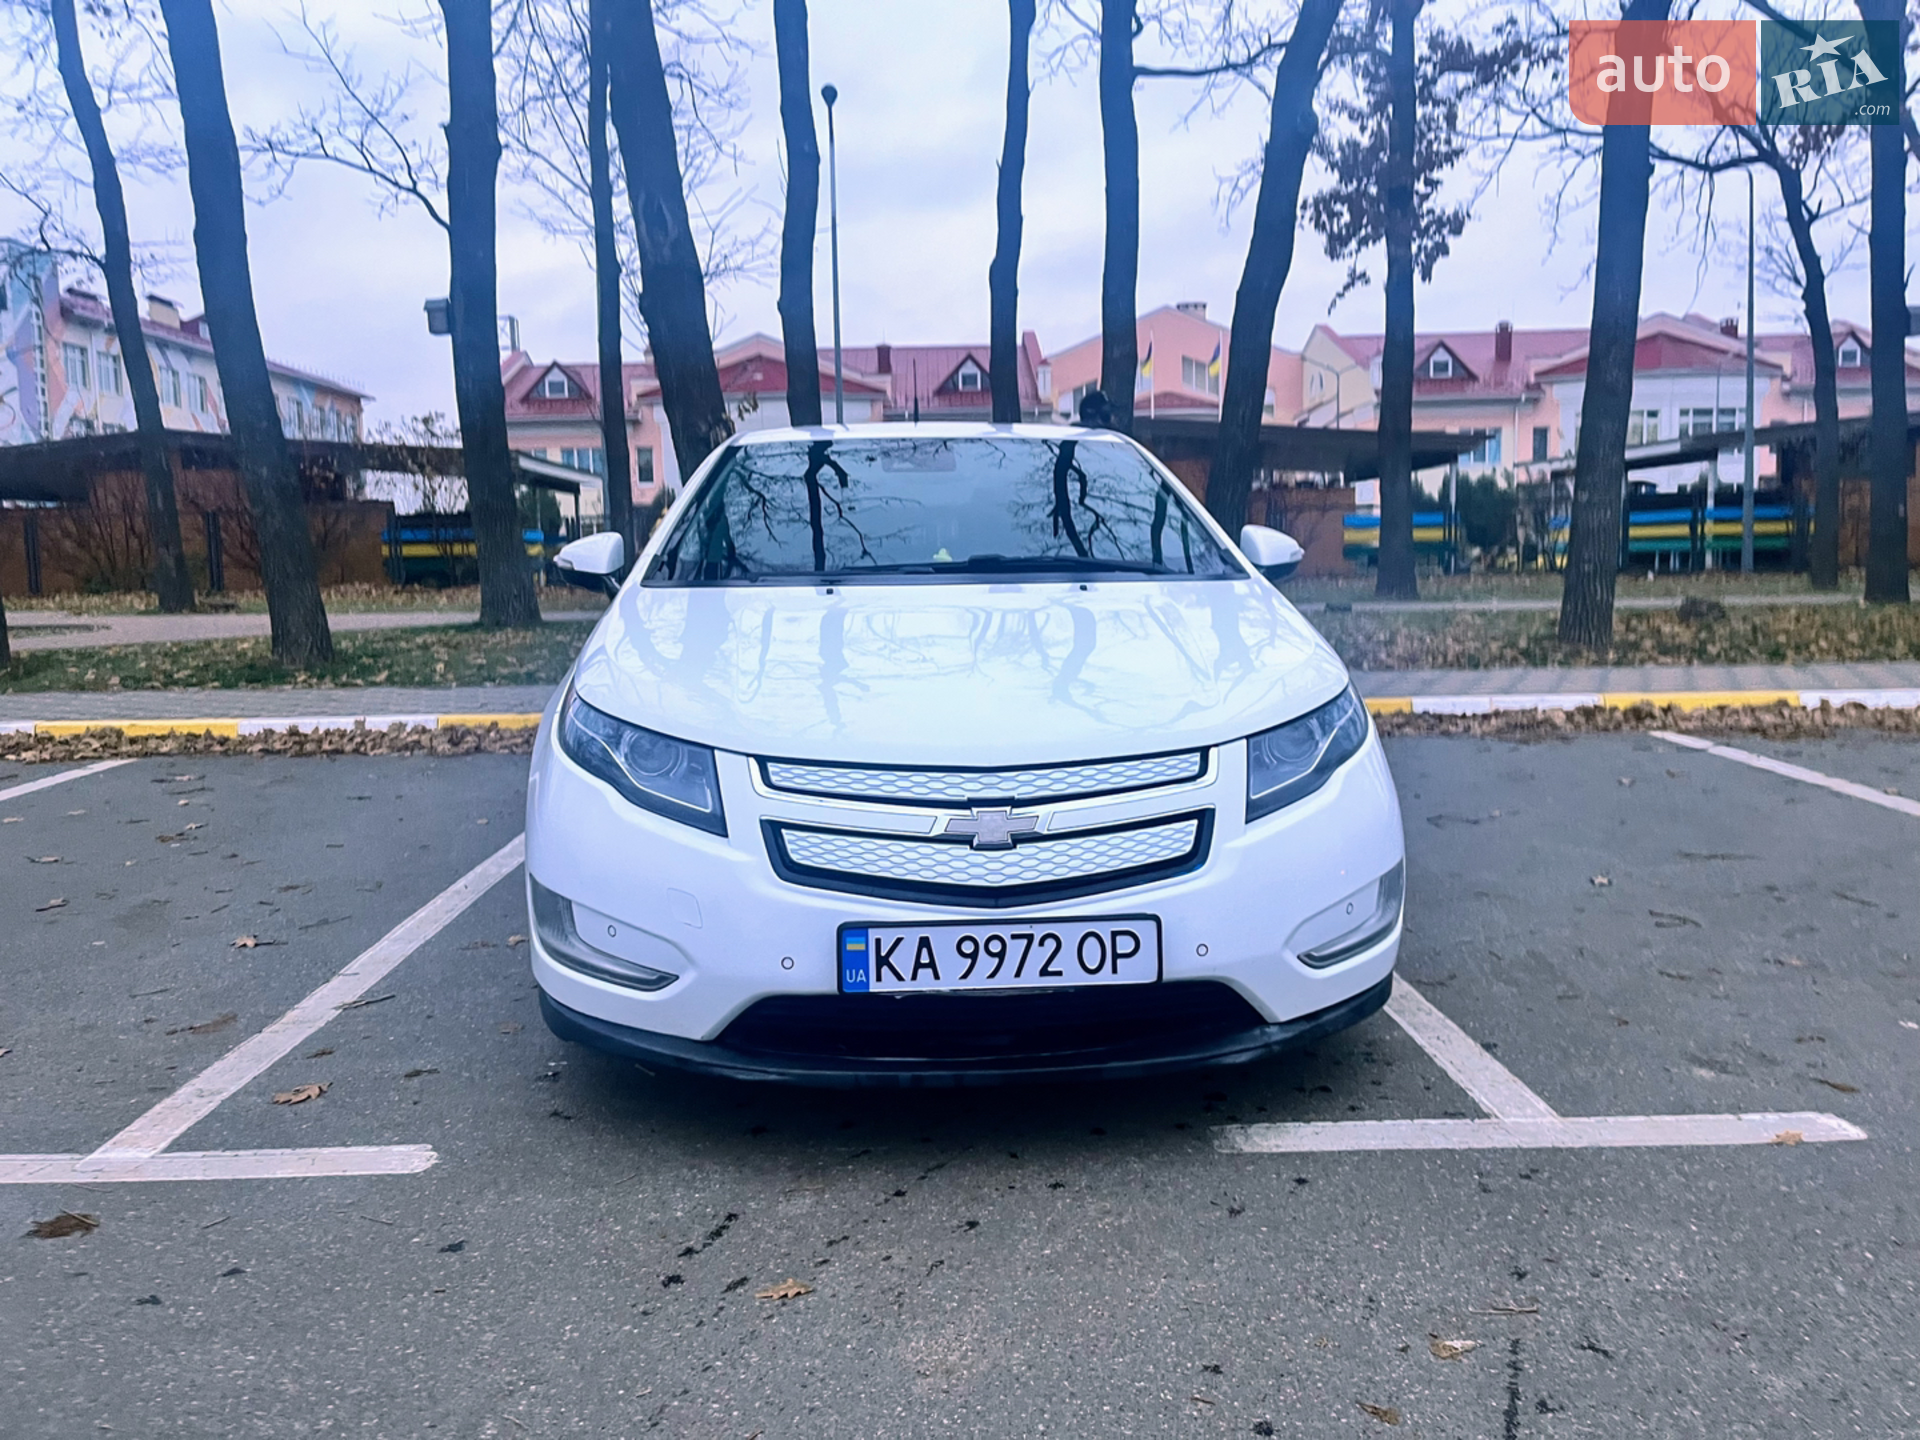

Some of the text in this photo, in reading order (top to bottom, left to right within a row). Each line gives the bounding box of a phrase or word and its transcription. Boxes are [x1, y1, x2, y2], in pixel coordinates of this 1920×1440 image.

[874, 929, 1141, 983] KA 9972 OP
[845, 969, 867, 984] UA
